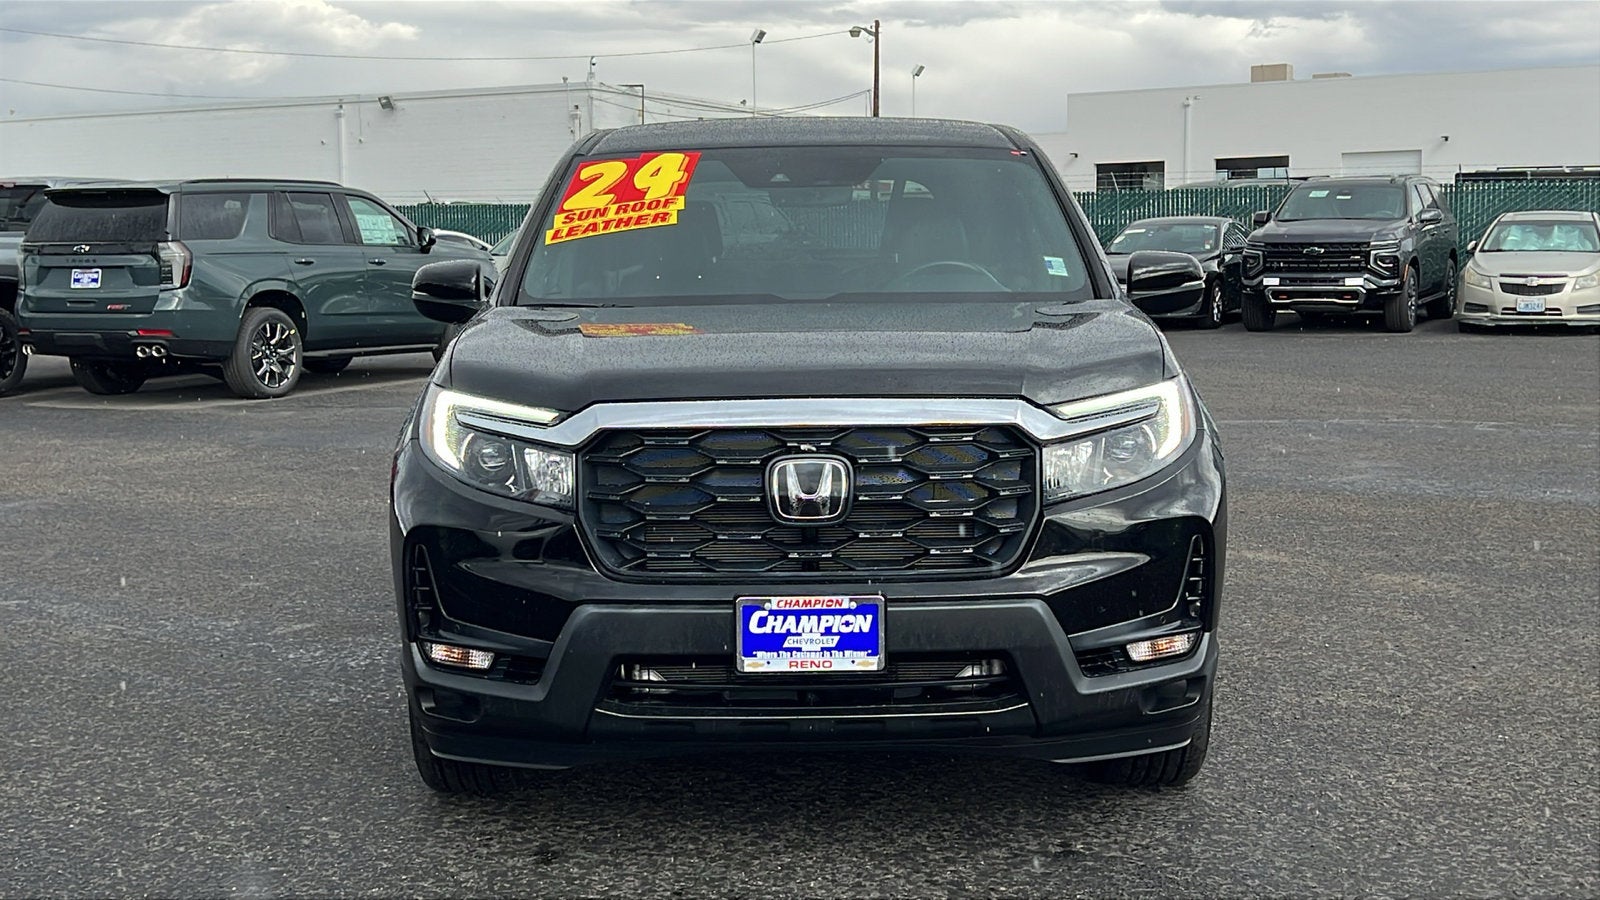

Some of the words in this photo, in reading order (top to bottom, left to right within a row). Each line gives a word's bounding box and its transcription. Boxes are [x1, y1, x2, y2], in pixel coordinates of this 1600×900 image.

[562, 152, 689, 211] 24
[561, 207, 611, 225] SUN
[615, 197, 679, 216] ROOF
[550, 211, 673, 242] LEATHER
[776, 599, 844, 608] CHAMPION
[749, 610, 873, 634] CHAMPION
[788, 660, 833, 669] RENO
